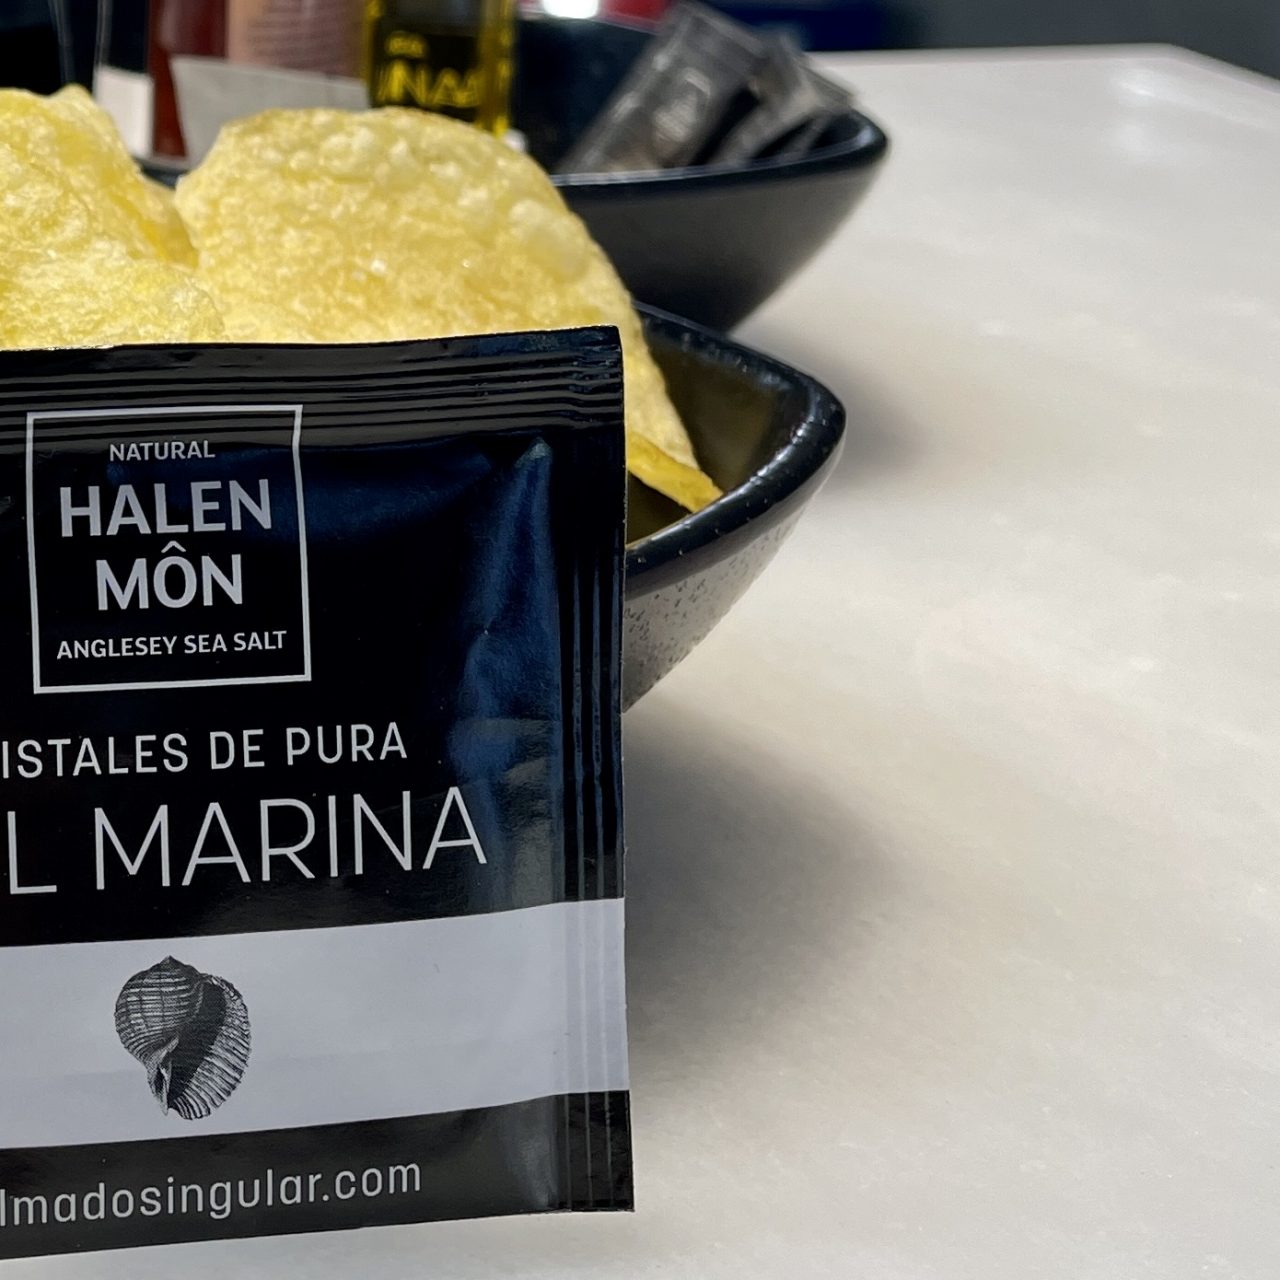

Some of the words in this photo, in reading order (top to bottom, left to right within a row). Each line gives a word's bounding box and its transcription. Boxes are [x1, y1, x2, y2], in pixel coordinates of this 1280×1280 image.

[111, 441, 214, 460] NATURAL
[61, 480, 271, 536] HALEN
[97, 541, 242, 610] MÔN
[57, 637, 176, 658] ANGLESEY
[185, 634, 226, 653] SEA
[234, 631, 286, 650] SALT
[210, 729, 264, 769] DE
[287, 722, 407, 765] PURA
[95, 787, 486, 889] MARINA
